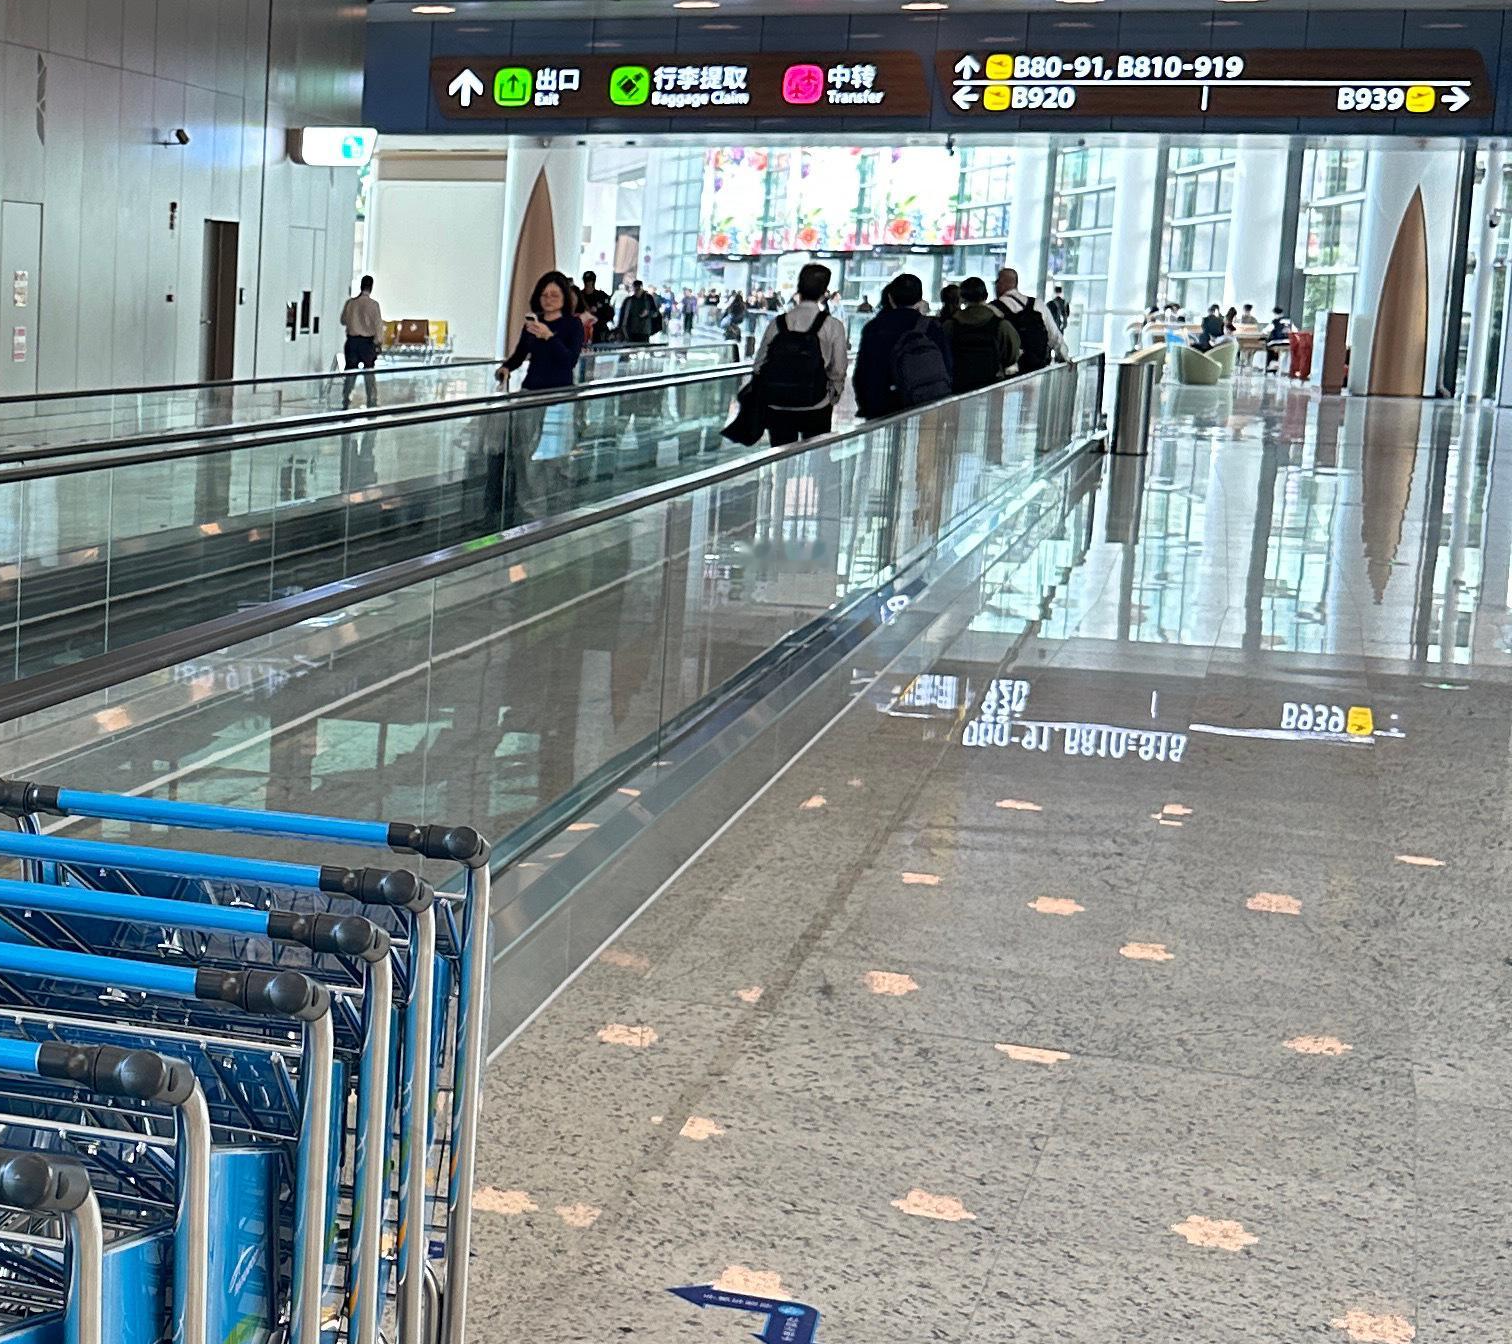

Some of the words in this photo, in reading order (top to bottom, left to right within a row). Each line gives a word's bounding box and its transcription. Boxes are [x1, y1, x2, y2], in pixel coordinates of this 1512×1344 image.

[653, 66, 748, 90] 行李提取
[827, 65, 876, 89] 中转
[1117, 57, 1244, 79] B810-919
[535, 68, 580, 91] 出口
[534, 92, 559, 106] Exit
[651, 92, 708, 108] Baggage
[711, 92, 749, 106] Claim
[827, 90, 885, 105] Transfer
[1011, 87, 1075, 109] B920
[1337, 87, 1405, 111] B939
